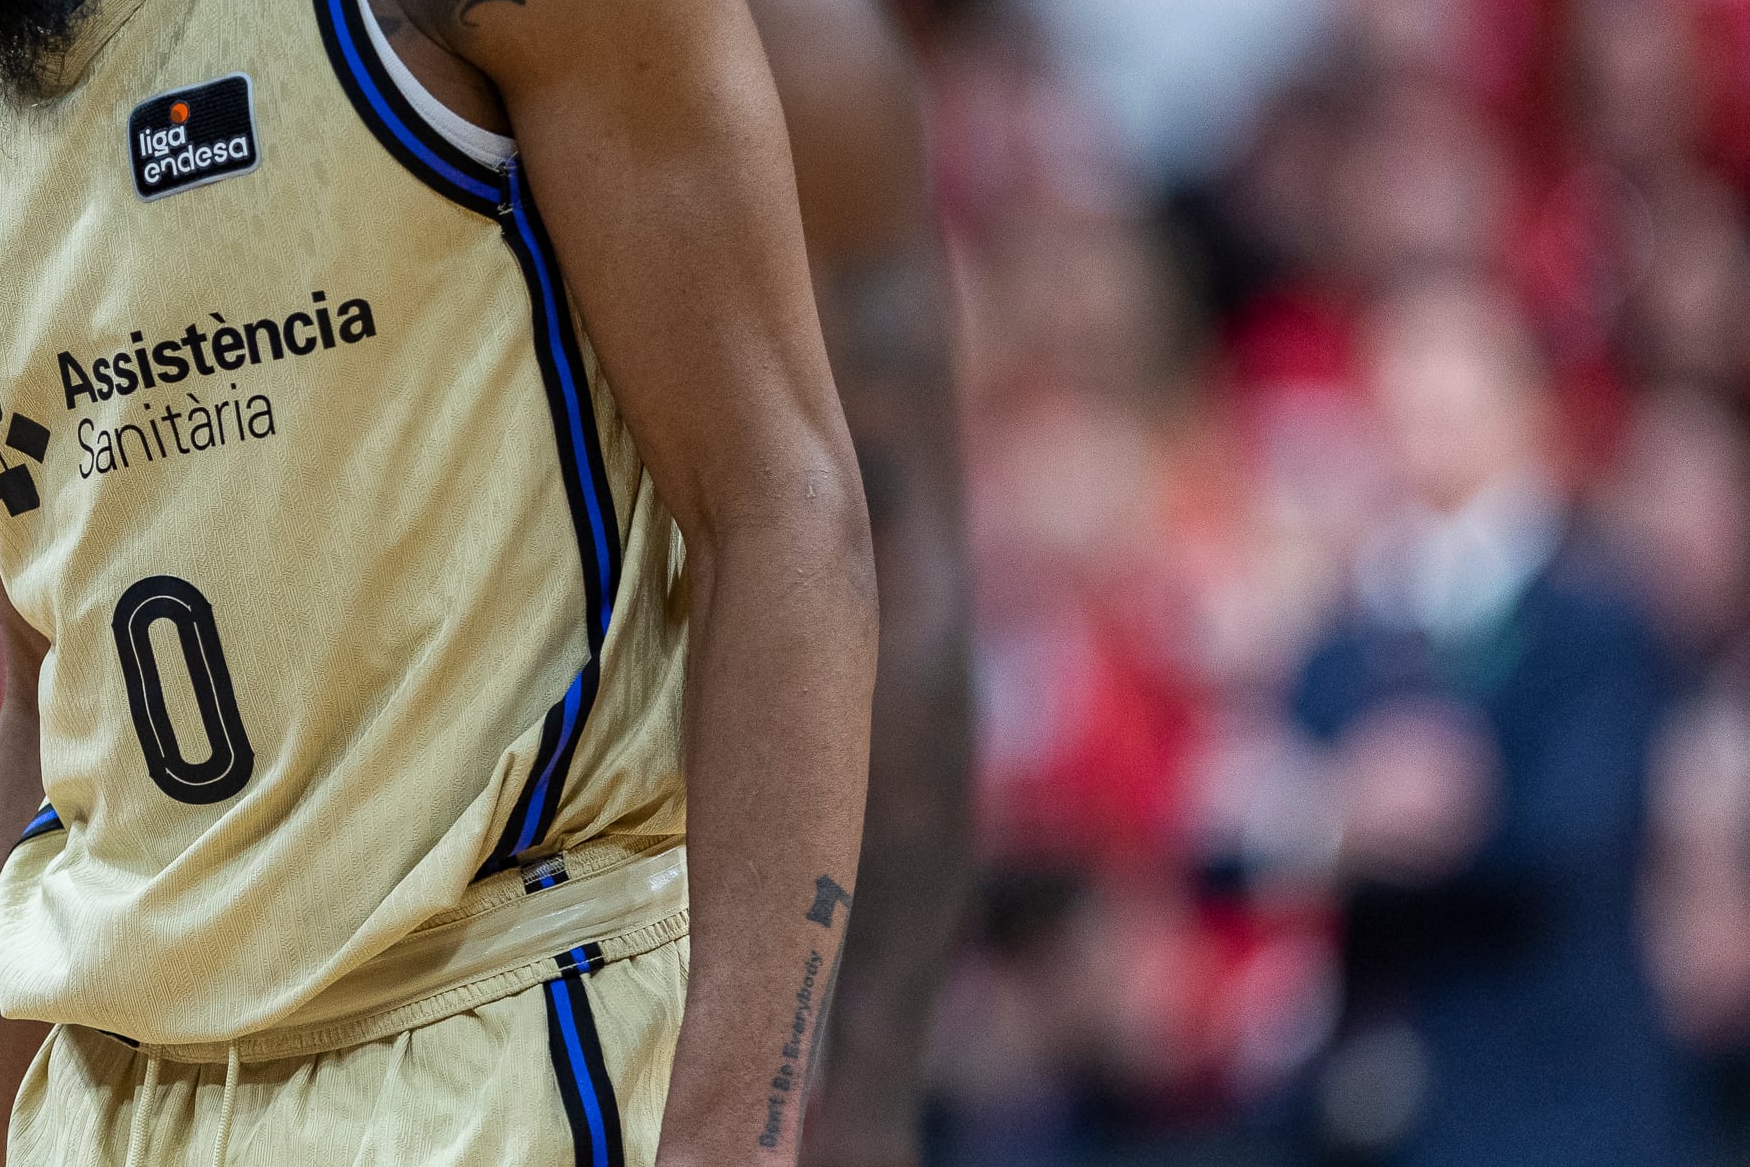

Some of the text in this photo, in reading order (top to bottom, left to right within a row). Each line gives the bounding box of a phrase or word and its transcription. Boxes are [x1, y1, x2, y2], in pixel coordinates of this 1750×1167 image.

[139, 125, 187, 158] liga
[144, 136, 249, 184] endesa
[56, 290, 377, 410] Assistència
[78, 385, 277, 480] Sanitària
[111, 575, 255, 805] 0
[782, 949, 824, 1060] Everybody
